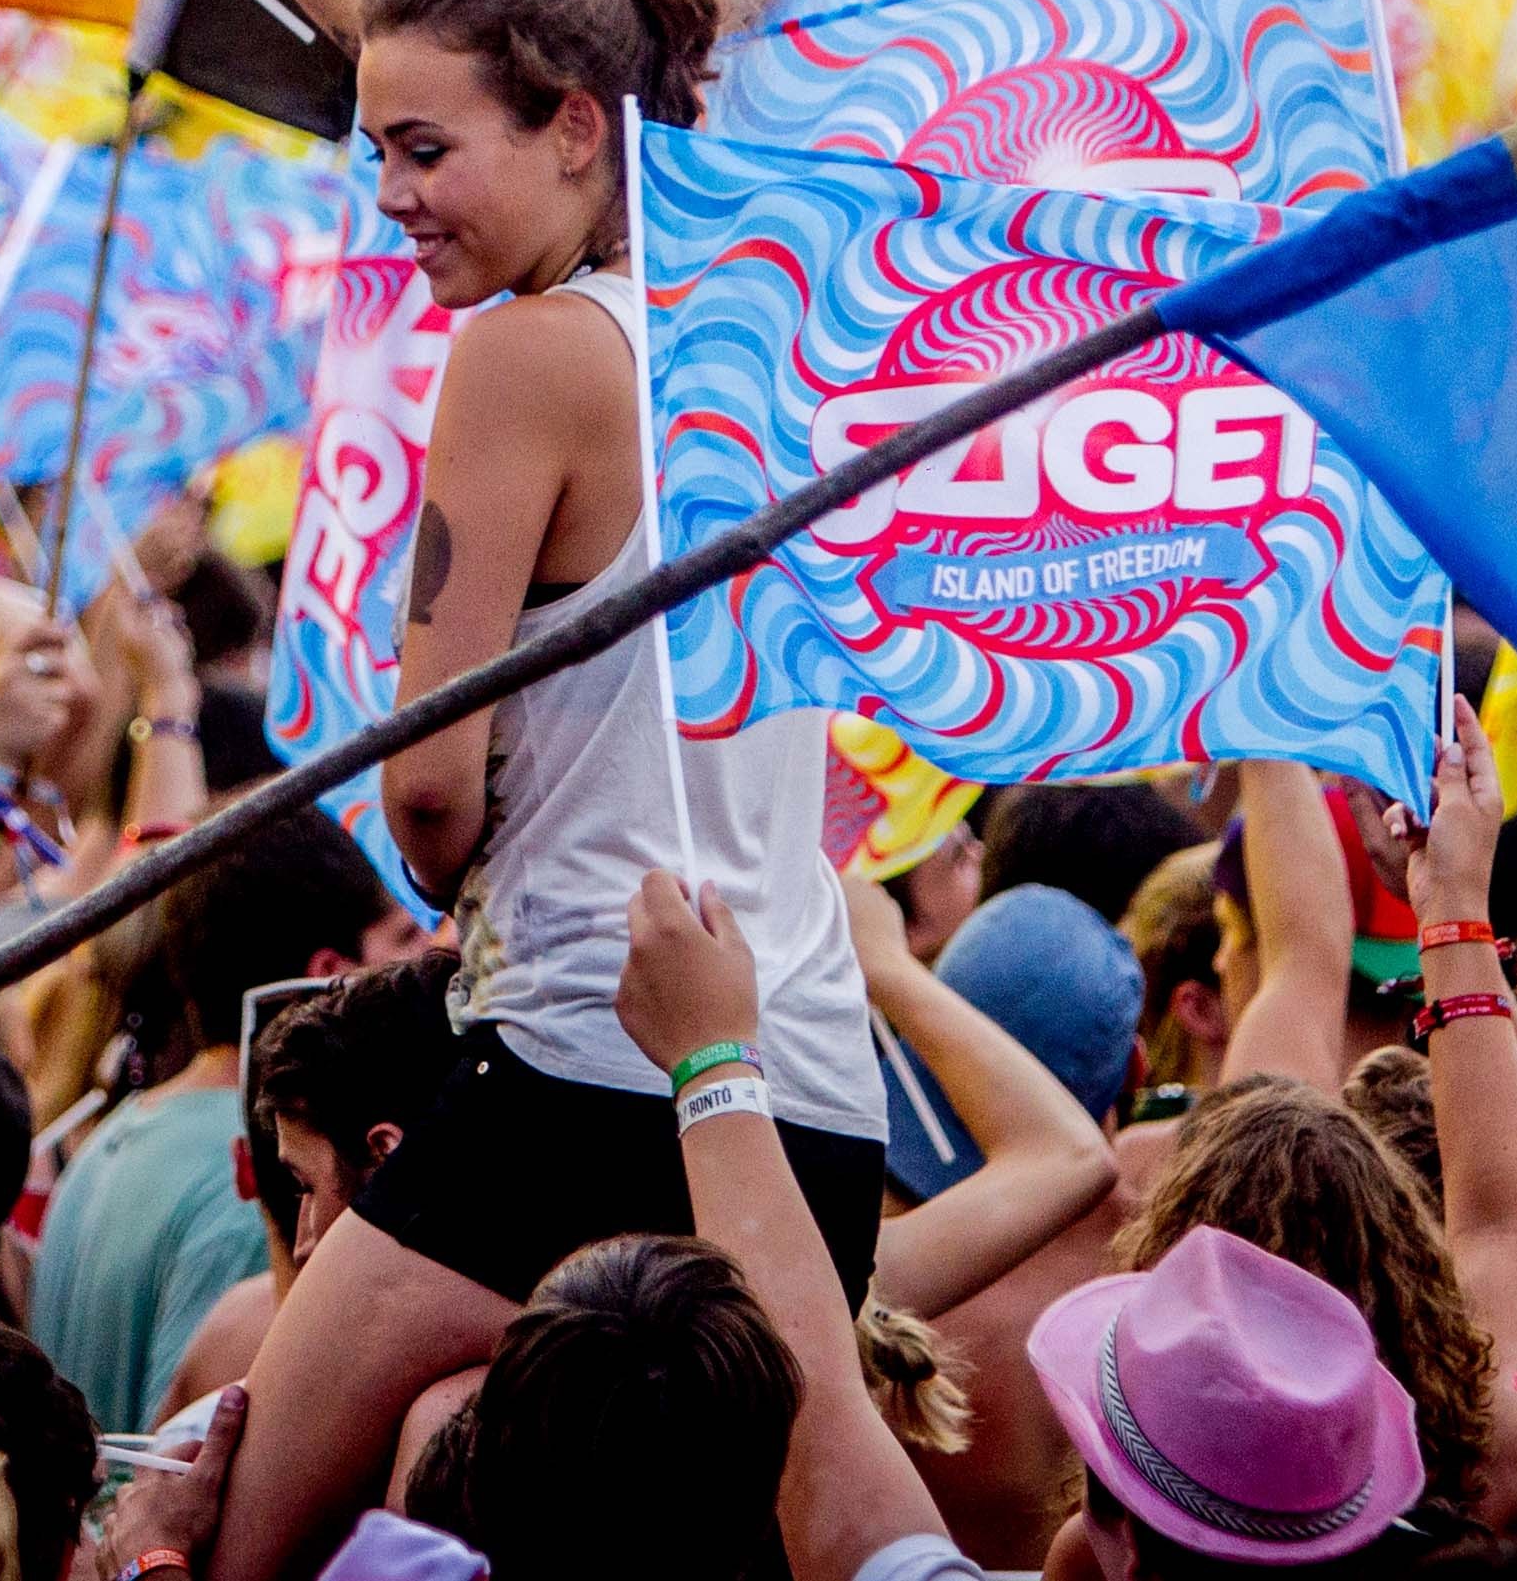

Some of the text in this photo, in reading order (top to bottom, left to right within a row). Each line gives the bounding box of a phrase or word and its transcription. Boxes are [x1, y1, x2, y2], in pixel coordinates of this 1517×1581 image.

[932, 536, 1207, 602] ISLAND OF FREEDOM
